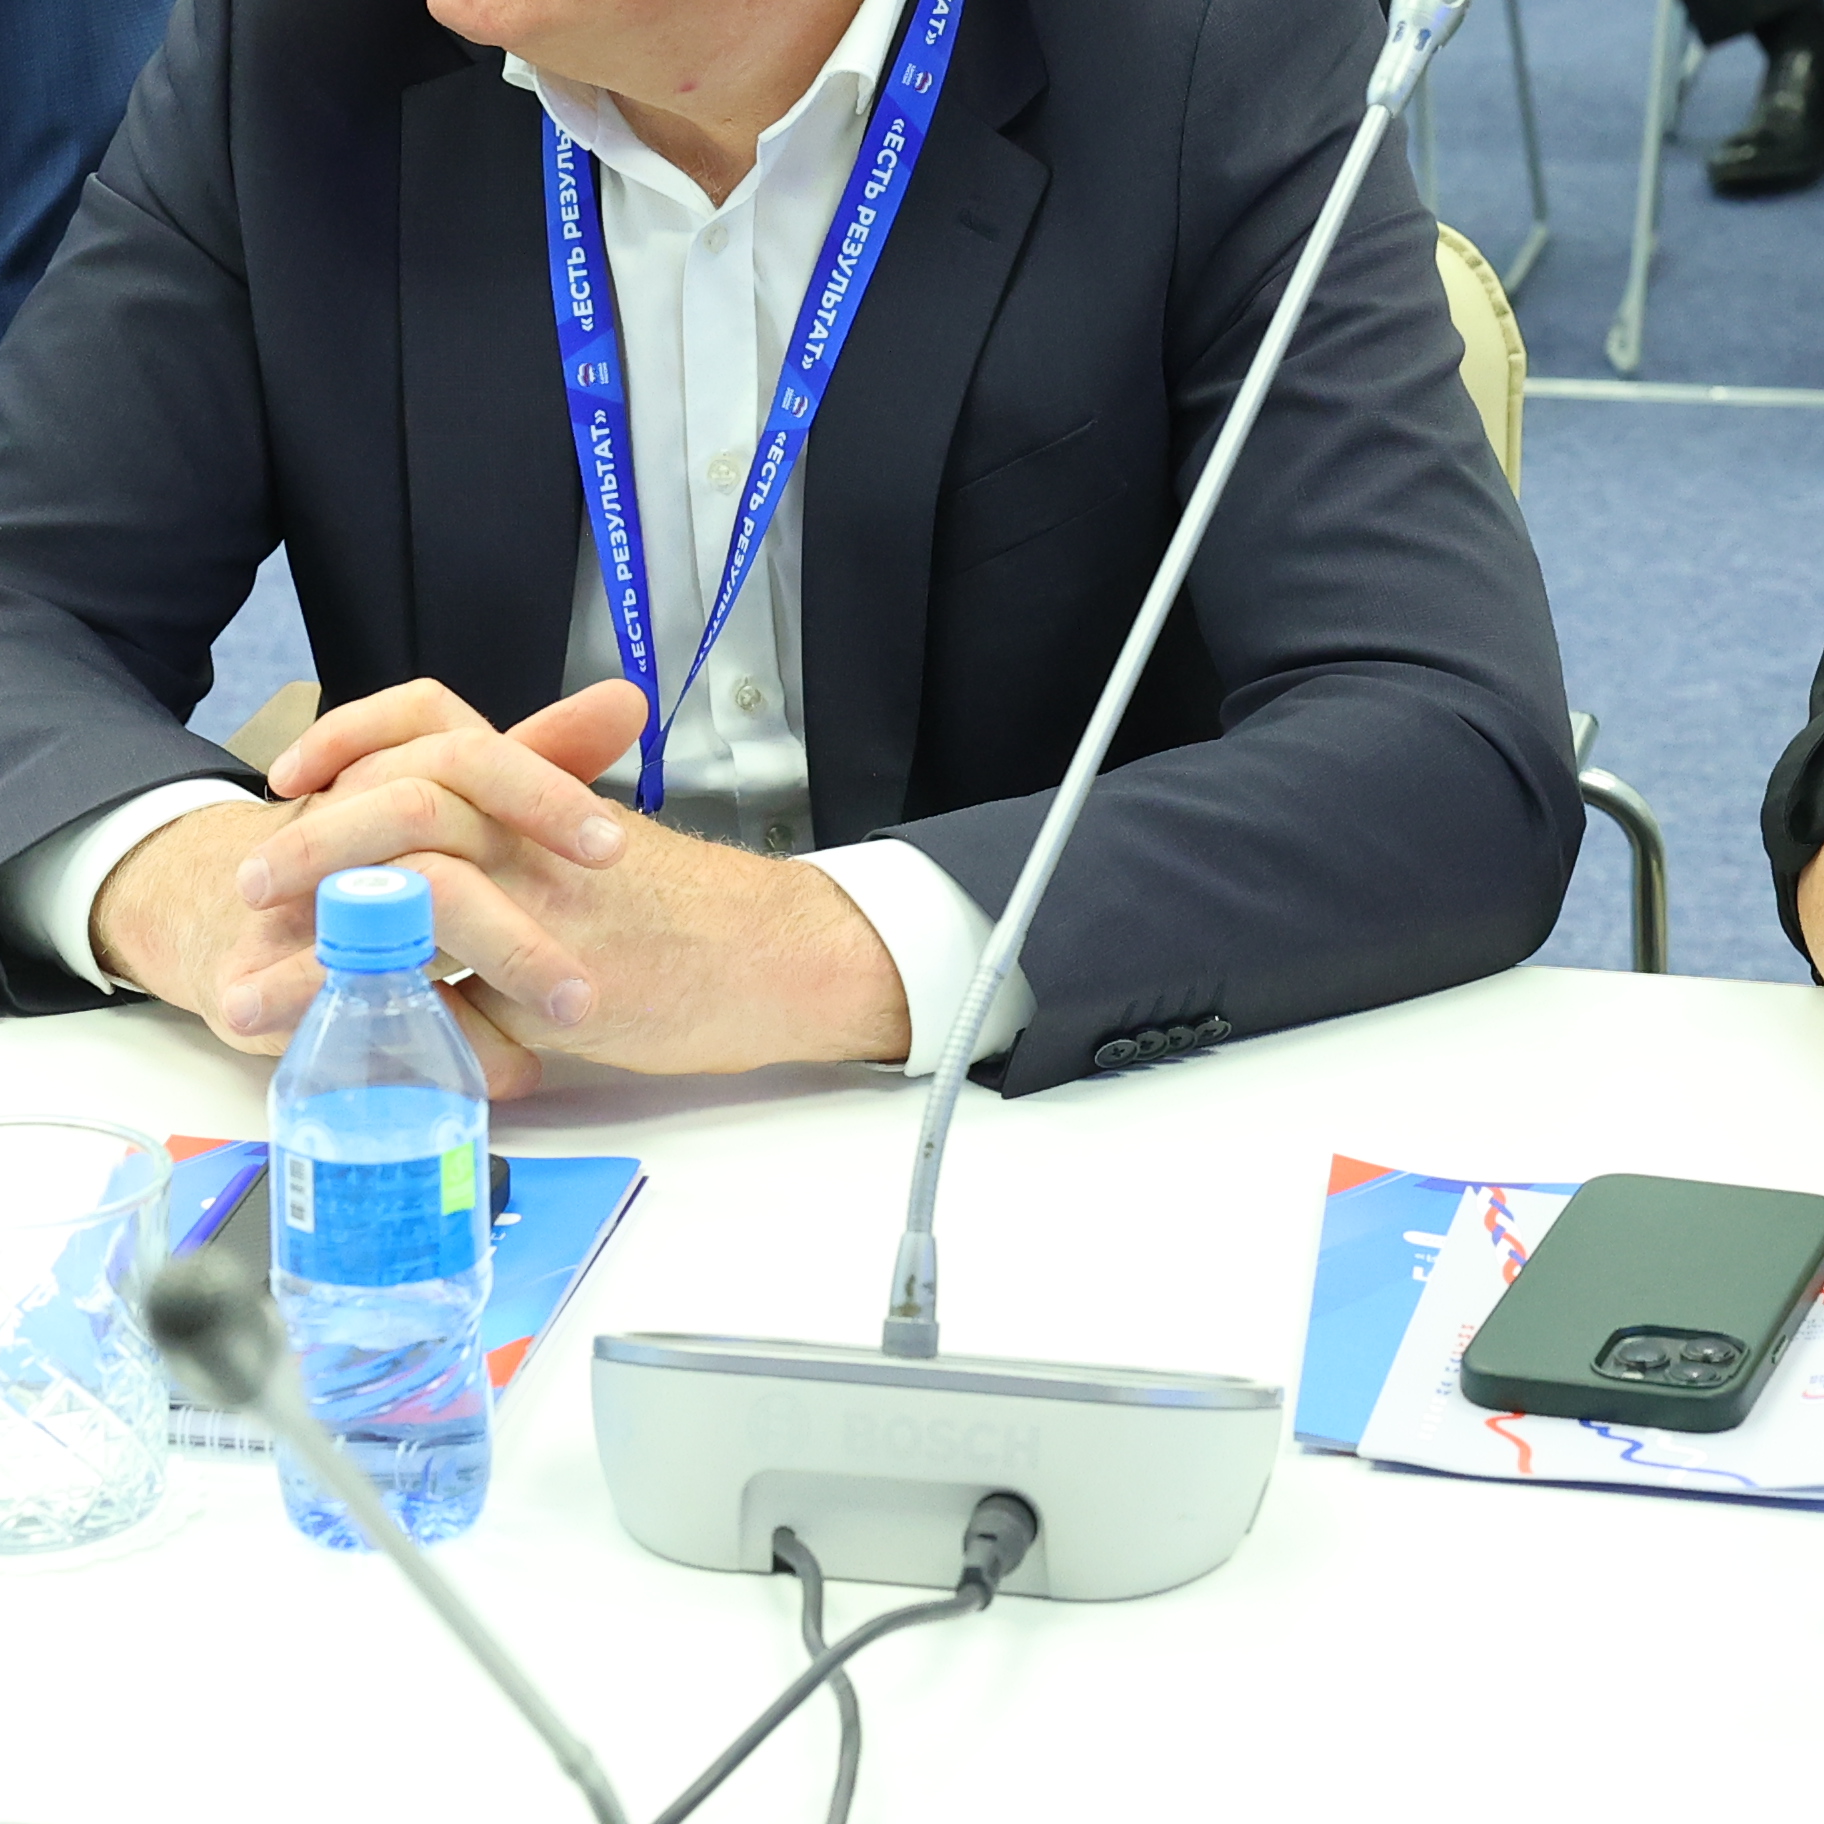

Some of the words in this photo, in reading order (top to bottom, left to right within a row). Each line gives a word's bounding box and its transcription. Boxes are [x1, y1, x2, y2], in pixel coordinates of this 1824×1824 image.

[864, 117, 906, 200] «ЕСТЬ
[566, 246, 594, 332] «ЕСТЬ
[801, 204, 878, 370] РЕЗУЛЬТАТ»
[590, 409, 633, 582] РЕЗУЛЬТАТ»
[749, 431, 787, 512] «ЕСТЬ
[622, 588, 648, 673] «ЕСТЬ
